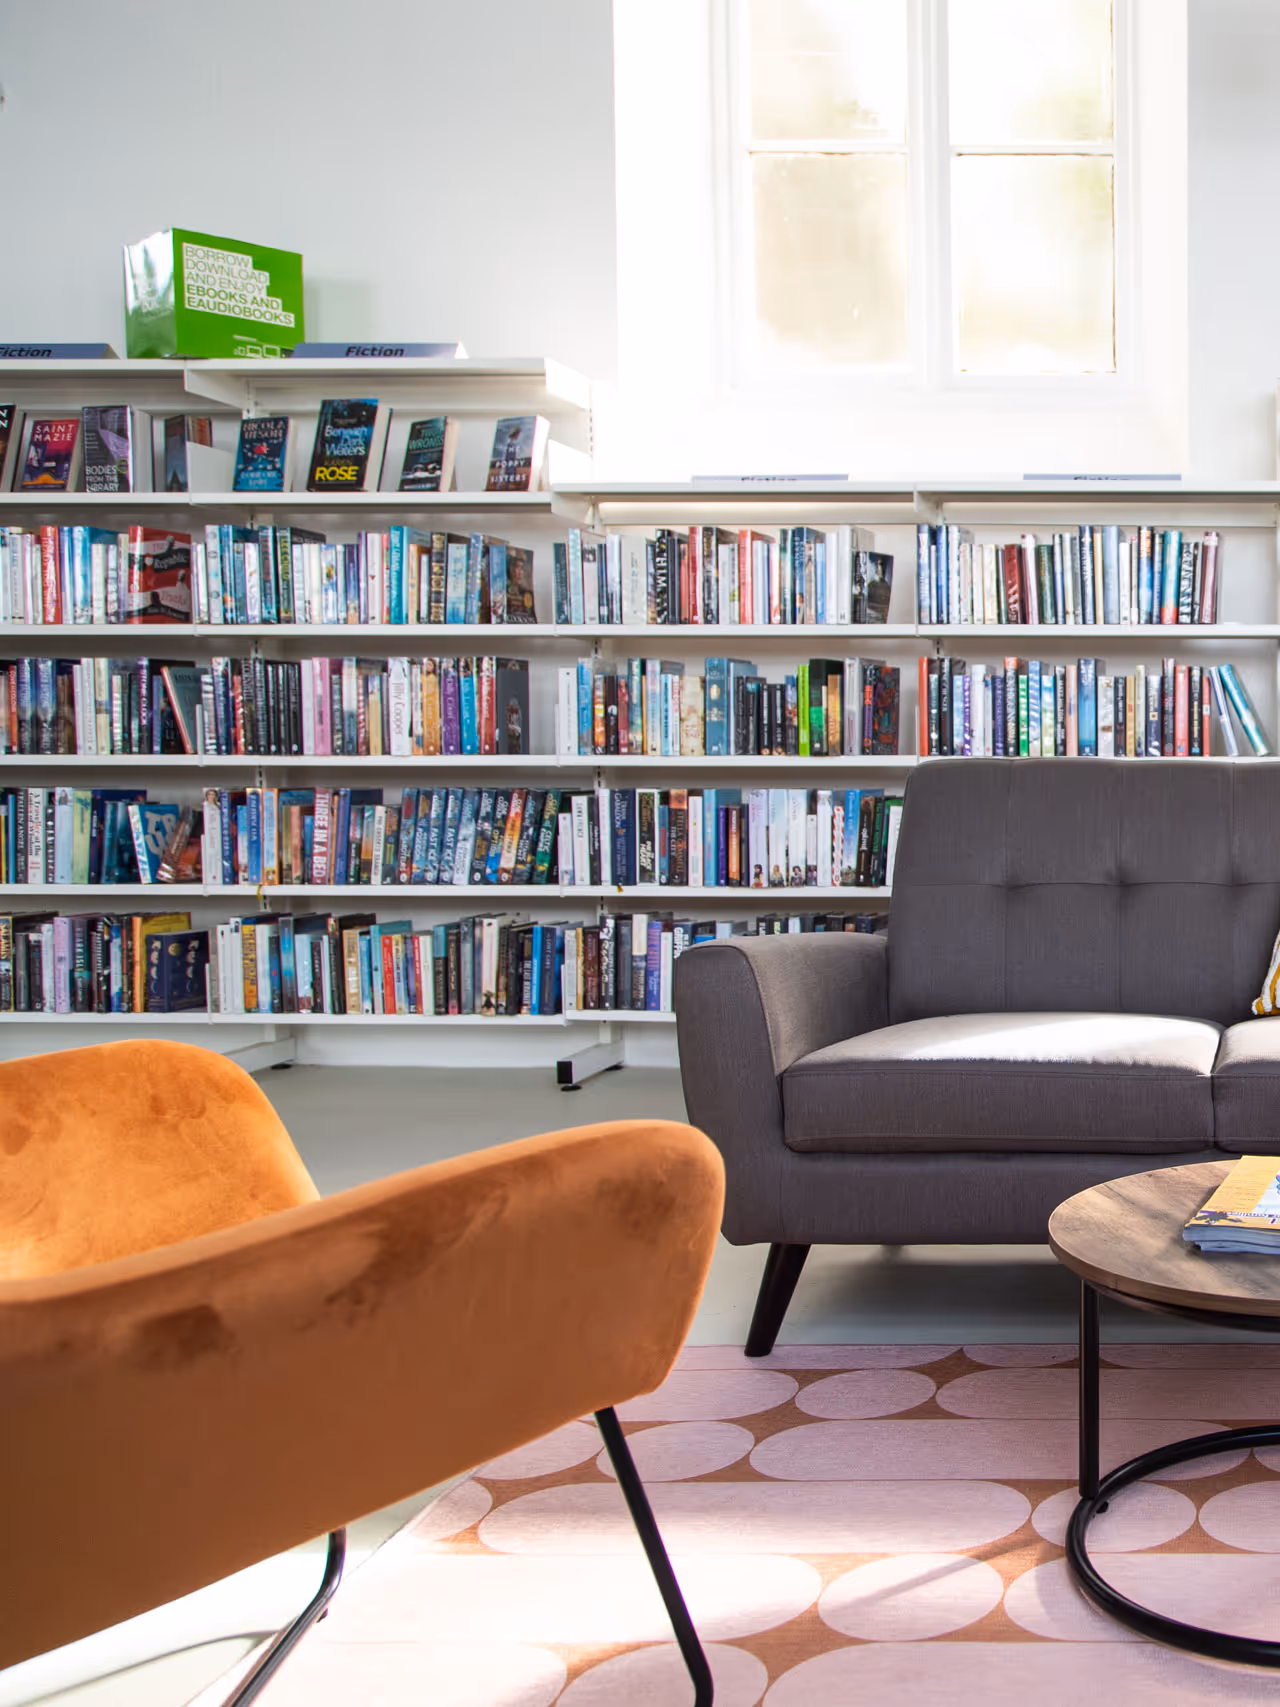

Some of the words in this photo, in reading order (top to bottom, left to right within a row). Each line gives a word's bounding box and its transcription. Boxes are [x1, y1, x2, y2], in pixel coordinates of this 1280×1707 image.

[185, 245, 251, 268] BORROW
[185, 258, 268, 285] DOWNLOAD
[187, 272, 216, 286] AND
[220, 278, 265, 296] ENJOY
[187, 284, 247, 305] EBOOKS
[251, 296, 280, 310] AND
[187, 297, 293, 325] EAUDIOBOOKS
[346, 346, 404, 357] Fiction
[36, 424, 75, 433] SAINT
[33, 433, 72, 442] MAZIE
[409, 436, 444, 449] WRONGS
[325, 444, 366, 456] Waters
[86, 465, 116, 474] BODIES
[315, 466, 359, 481] ROSE
[490, 474, 527, 482] SISTERS
[393, 683, 405, 699] Jilly
[393, 702, 405, 735] Cooper
[315, 794, 328, 827] THREE
[17, 825, 25, 849] ANGEL
[315, 828, 326, 842] IN
[429, 828, 439, 845] FAST
[445, 828, 455, 845] FAST
[315, 844, 326, 854] A
[428, 848, 438, 860] ICE
[444, 848, 453, 860] ICE
[314, 856, 326, 878] BED
